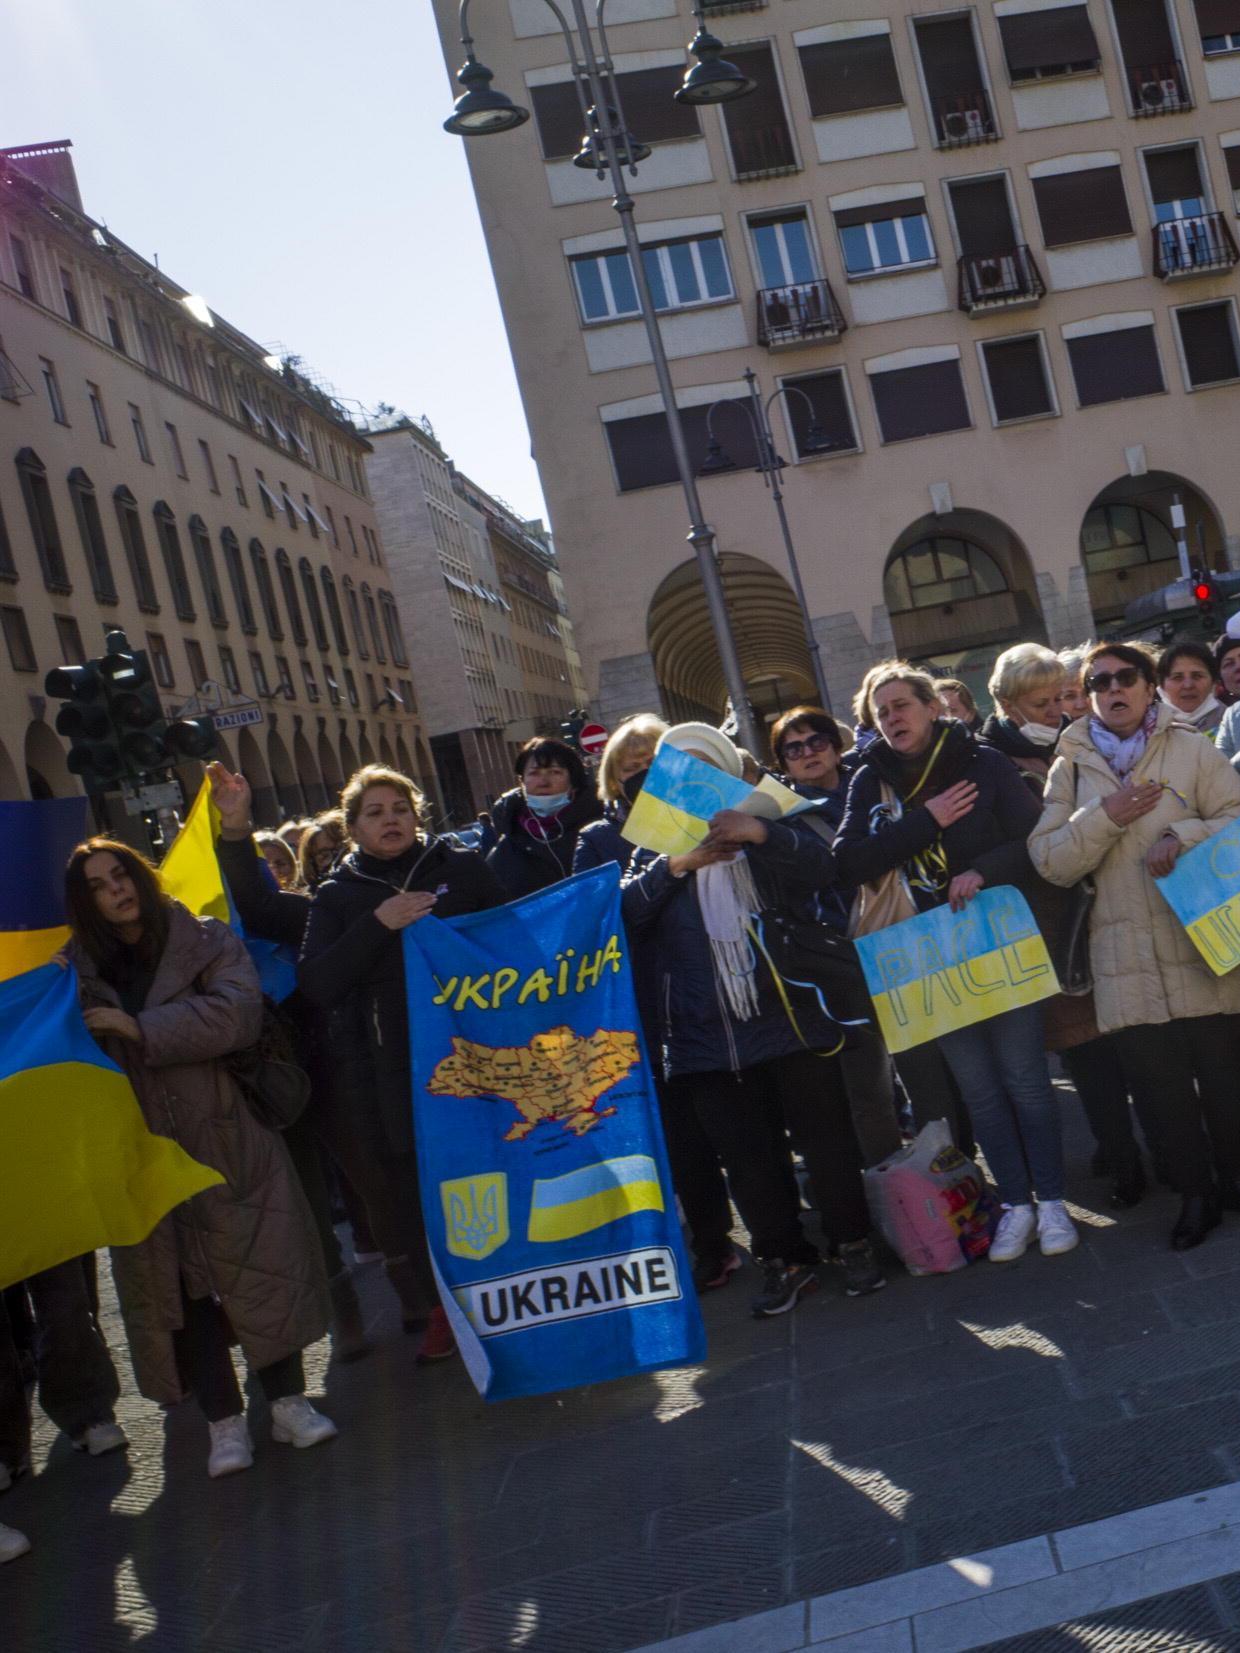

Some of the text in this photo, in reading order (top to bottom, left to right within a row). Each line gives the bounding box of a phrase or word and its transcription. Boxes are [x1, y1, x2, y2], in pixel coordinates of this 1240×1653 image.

[215, 710, 260, 728] RAZIONI
[432, 934, 623, 1012] УКРАЇНА
[875, 903, 1049, 1027] PACE
[480, 1257, 671, 1328] UKRAINE
